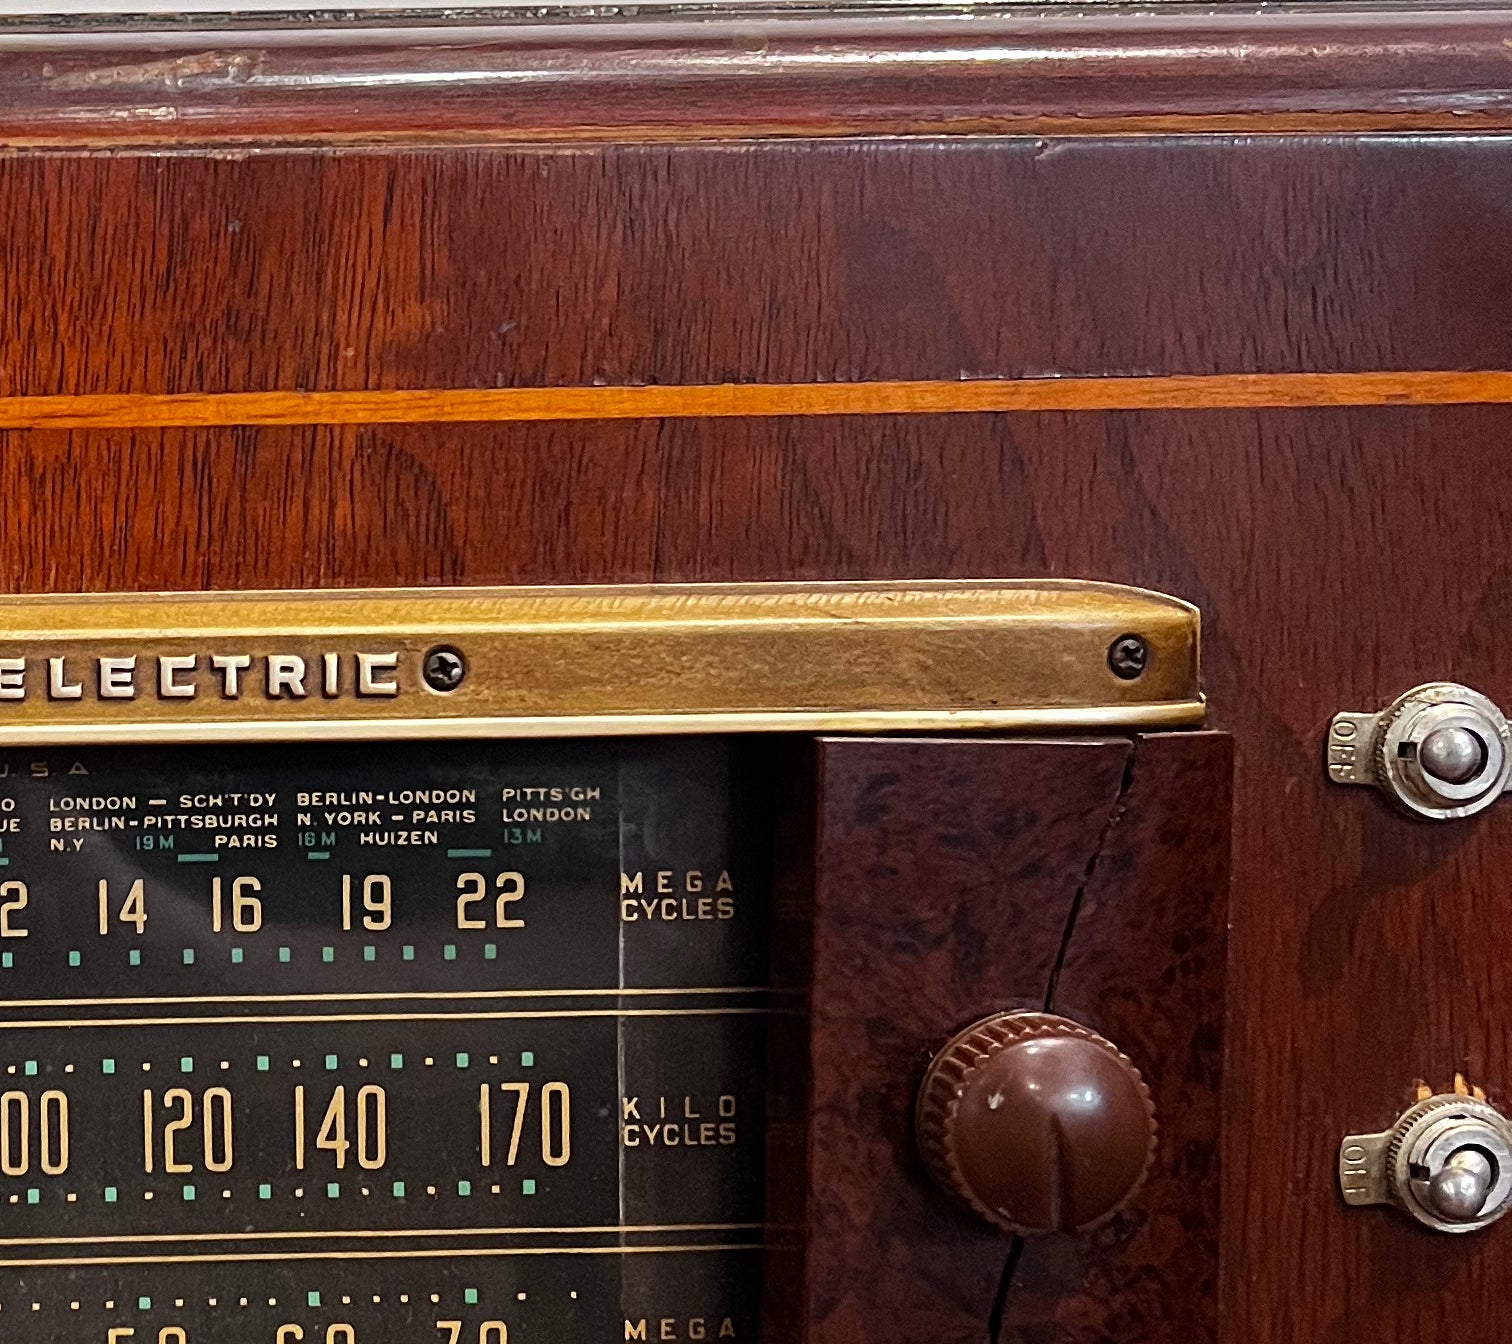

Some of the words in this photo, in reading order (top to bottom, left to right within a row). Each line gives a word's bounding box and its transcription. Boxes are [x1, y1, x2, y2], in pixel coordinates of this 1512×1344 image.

[49, 796, 137, 812] LONDON
[325, 810, 382, 826] YORK
[412, 808, 476, 824] PARIS
[502, 806, 591, 823] LONDON
[214, 834, 279, 849] PARIS
[359, 830, 439, 846] HUIZEN
[620, 869, 734, 895] MEGA
[99, 878, 149, 935] 14
[211, 876, 263, 934] 16
[342, 874, 393, 931] 19
[455, 871, 526, 929] 22
[620, 897, 736, 923] CYCLES
[622, 1095, 736, 1120] KILO
[143, 1086, 234, 1174] 120
[296, 1084, 388, 1171] 140
[481, 1081, 571, 1168] 170
[622, 1122, 736, 1147] CYCLES
[624, 1317, 736, 1341] MEGA
